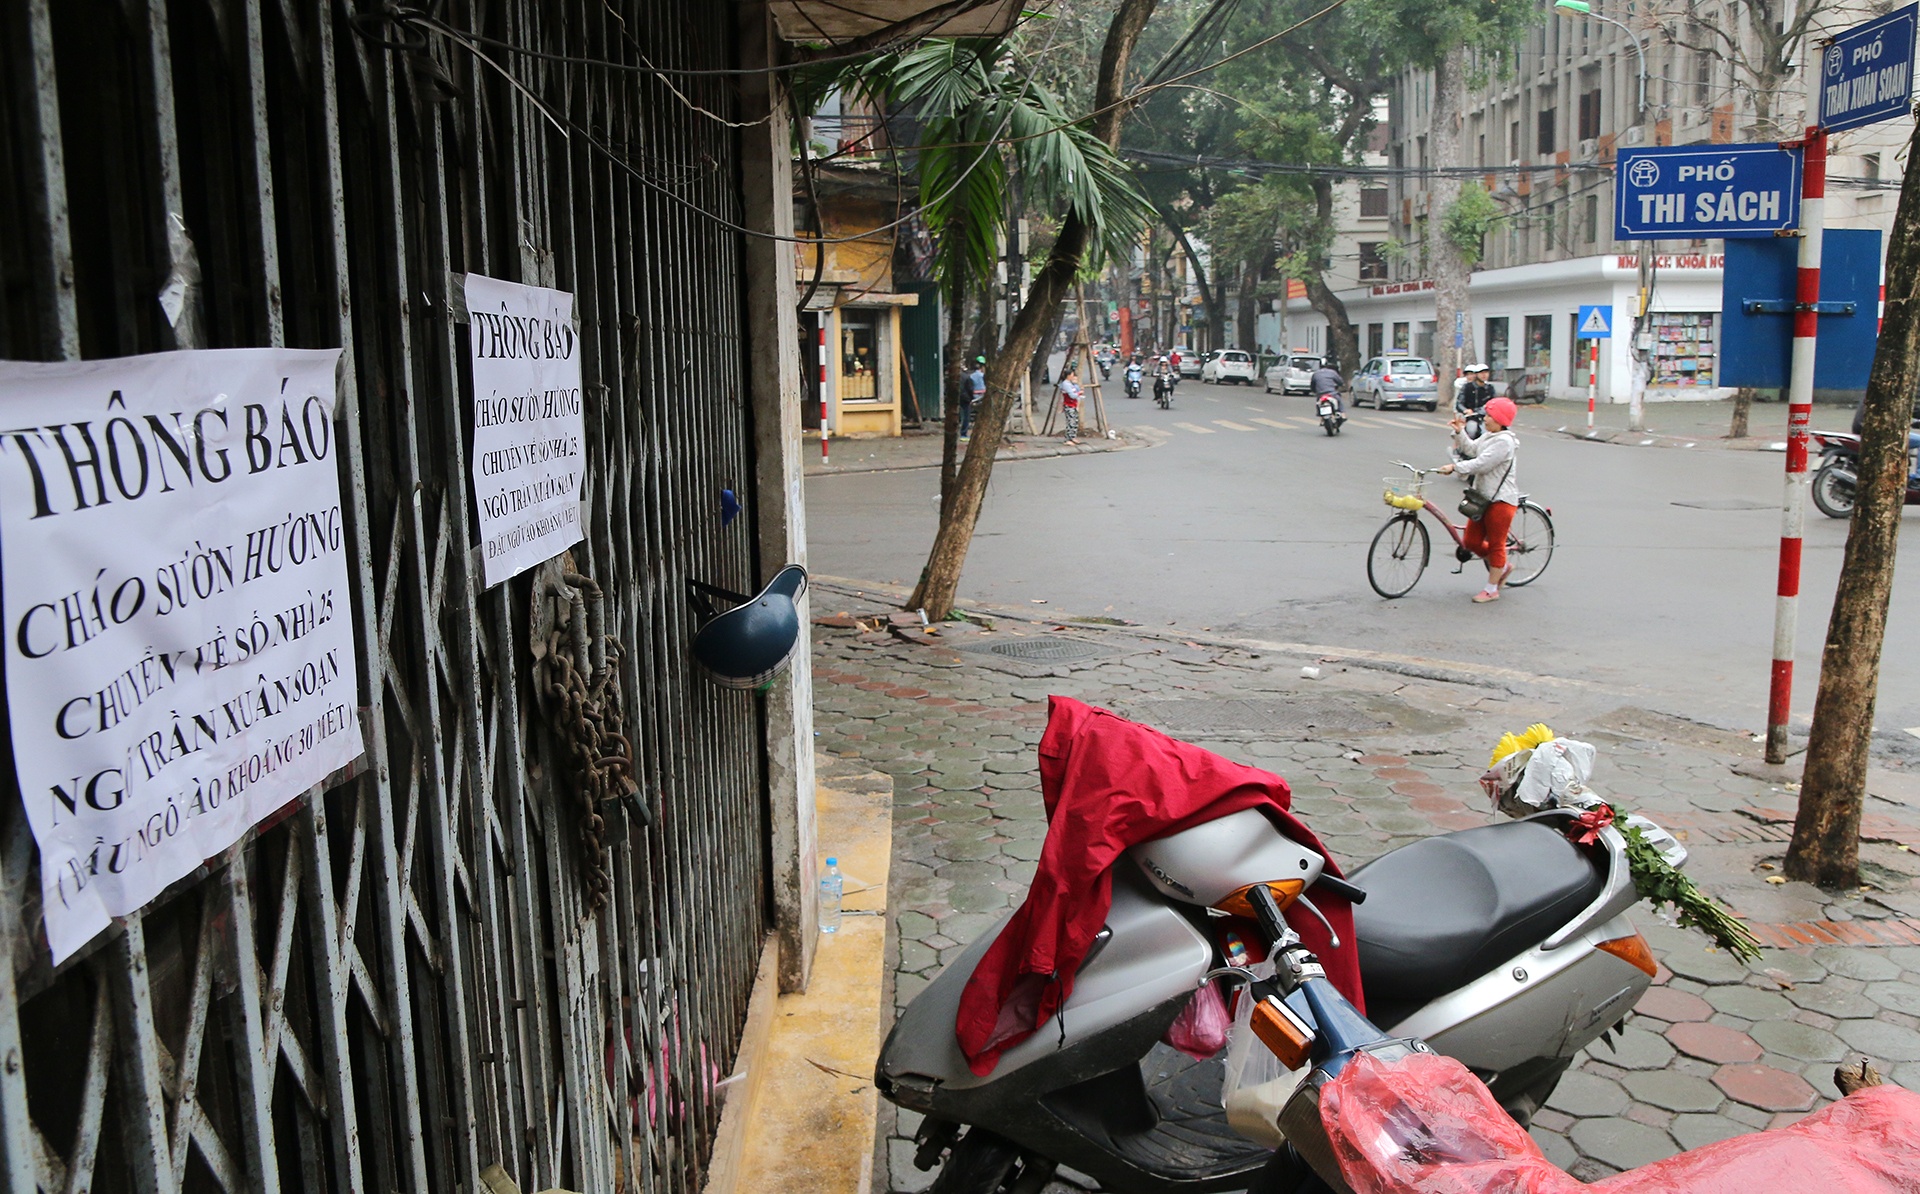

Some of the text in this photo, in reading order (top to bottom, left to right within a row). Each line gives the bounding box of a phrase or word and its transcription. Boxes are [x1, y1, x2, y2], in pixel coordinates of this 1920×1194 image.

[1852, 30, 1885, 66] PHỐ
[1826, 61, 1908, 118] TRẦN XUÂN SOẠN
[1678, 157, 1738, 182] PHỐ
[1638, 185, 1781, 225] THI SÁCH
[472, 300, 573, 361] THÔNG BÁO
[475, 389, 507, 428] CHÁO
[0, 377, 330, 520] THÔNG BÁO
[17, 505, 341, 659] CHÁO SƯỜN HƯƠNG
[56, 589, 334, 740] CHUYỂN VỀ SỐ NHÀ 25
[137, 710, 218, 782] TRẦN
[222, 673, 291, 739] XUÂN
[292, 648, 340, 703] SOẠN
[227, 735, 294, 800] KHOẢNG
[298, 723, 313, 756] 30
[316, 702, 345, 745] MÉT
